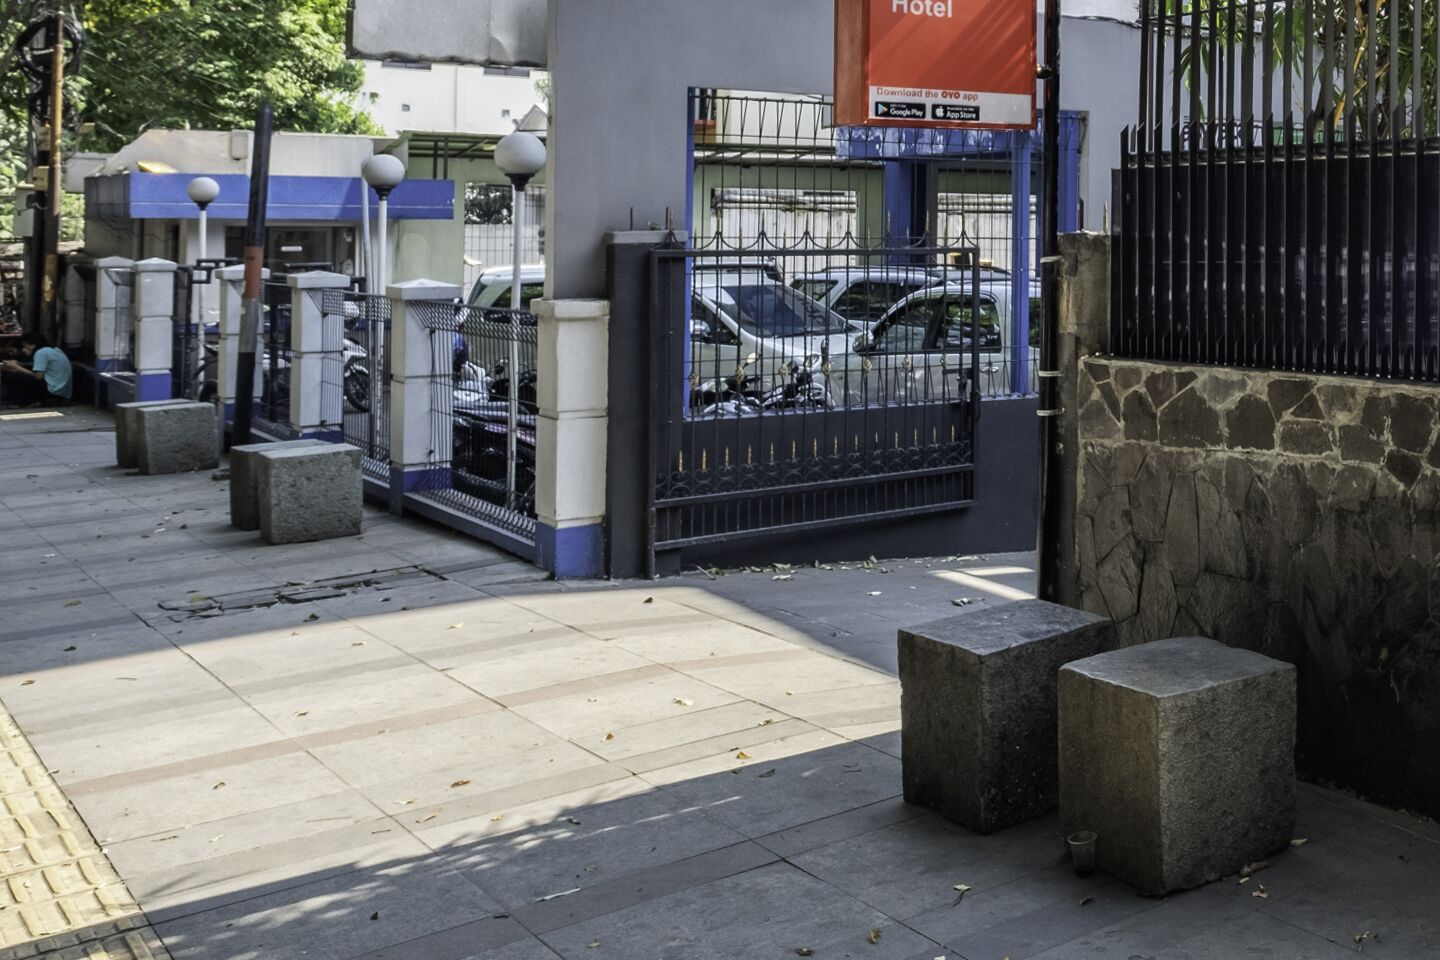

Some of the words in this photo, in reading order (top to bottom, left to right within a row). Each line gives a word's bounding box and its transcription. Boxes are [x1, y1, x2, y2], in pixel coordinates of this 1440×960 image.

[876, 87, 923, 98] Download
[924, 90, 939, 99] the
[941, 90, 961, 99] OYO
[962, 92, 979, 102] app
[889, 107, 911, 117] Google
[911, 108, 924, 117] Play
[946, 110, 960, 119] App
[960, 111, 977, 120] Store
